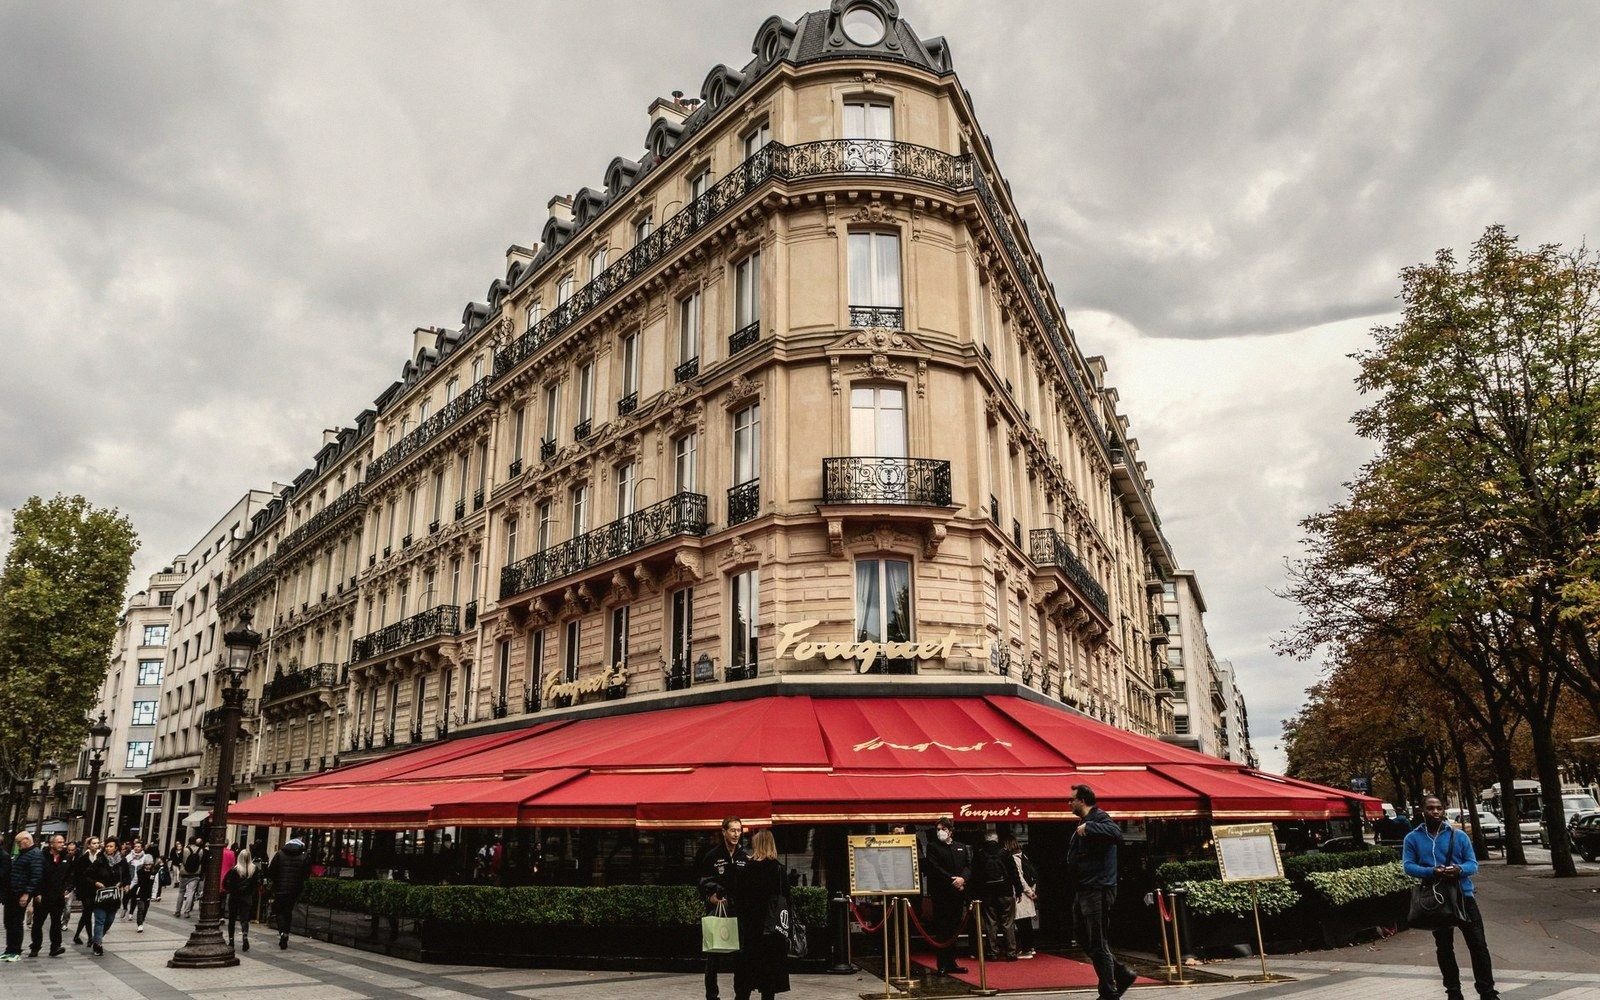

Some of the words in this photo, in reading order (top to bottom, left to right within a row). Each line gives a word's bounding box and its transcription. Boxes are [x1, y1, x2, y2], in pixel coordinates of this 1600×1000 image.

[776, 619, 992, 674] Fouquet's
[542, 662, 628, 705] Fouquet's
[960, 804, 1021, 820] Fouquet's
